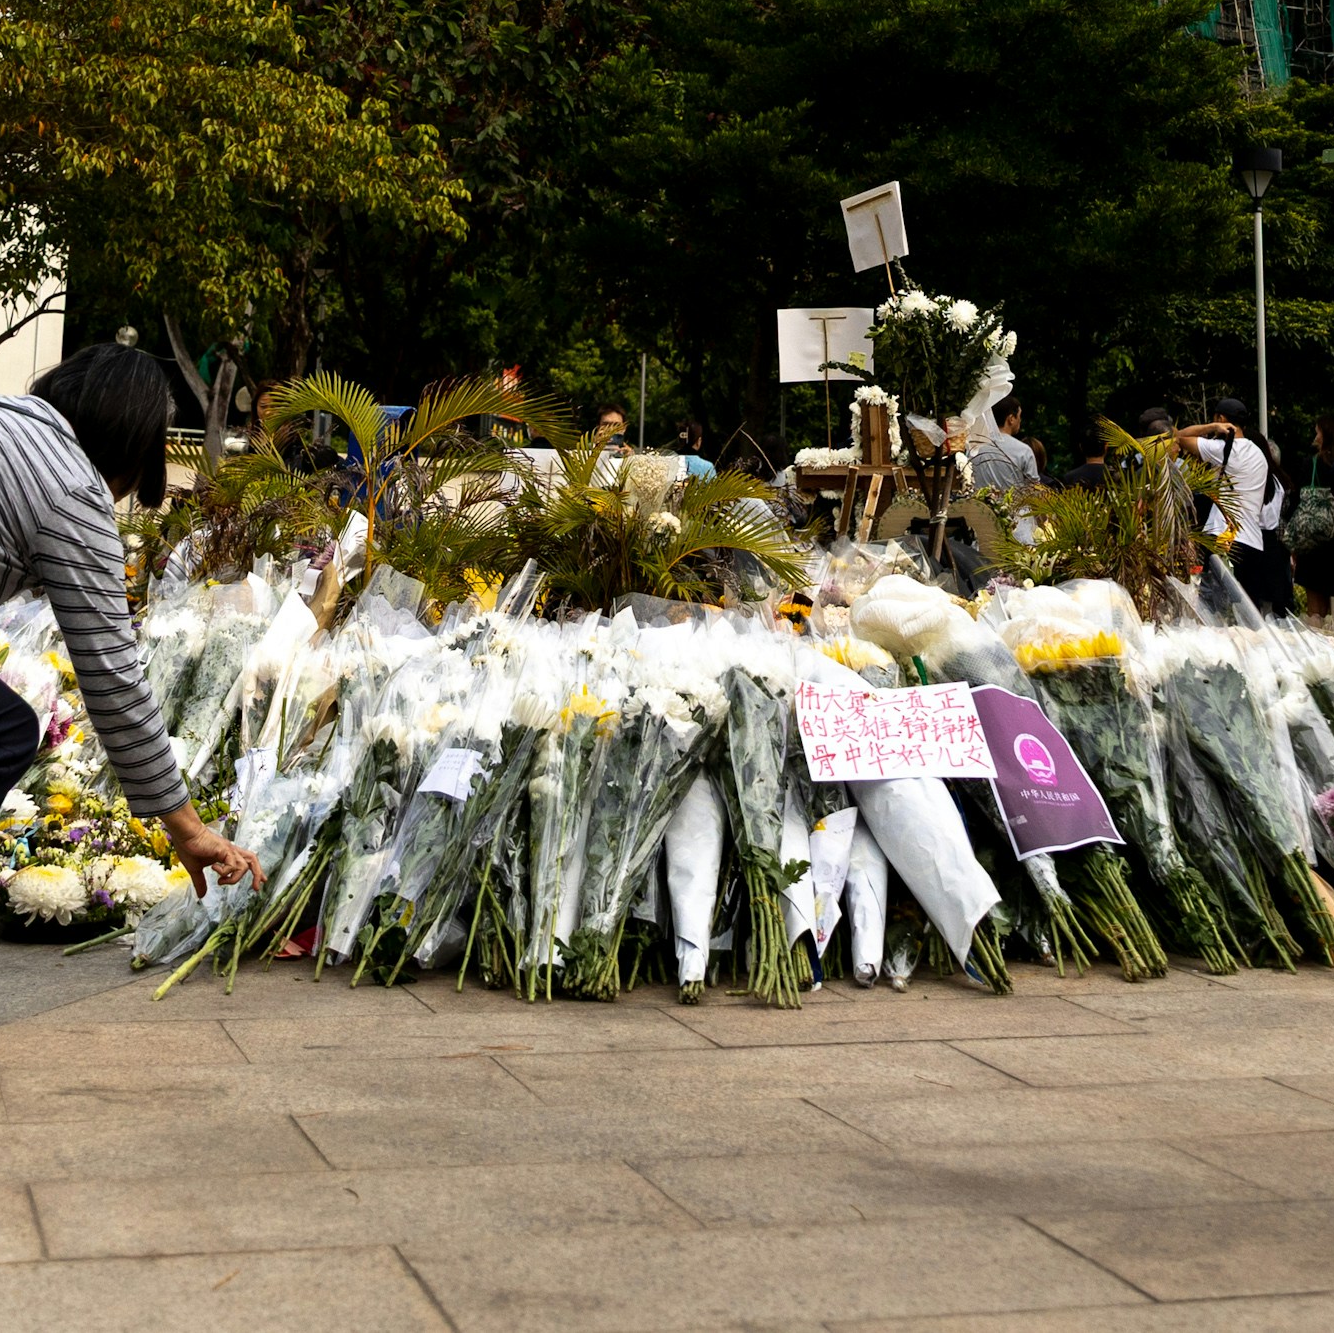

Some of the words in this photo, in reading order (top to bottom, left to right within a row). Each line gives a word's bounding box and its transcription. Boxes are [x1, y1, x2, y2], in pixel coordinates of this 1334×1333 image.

[795, 681, 965, 718] 伟大复兴真正
[811, 741, 991, 777] 骨中华好儿女
[1020, 788, 1081, 802] 中华人民共和国
